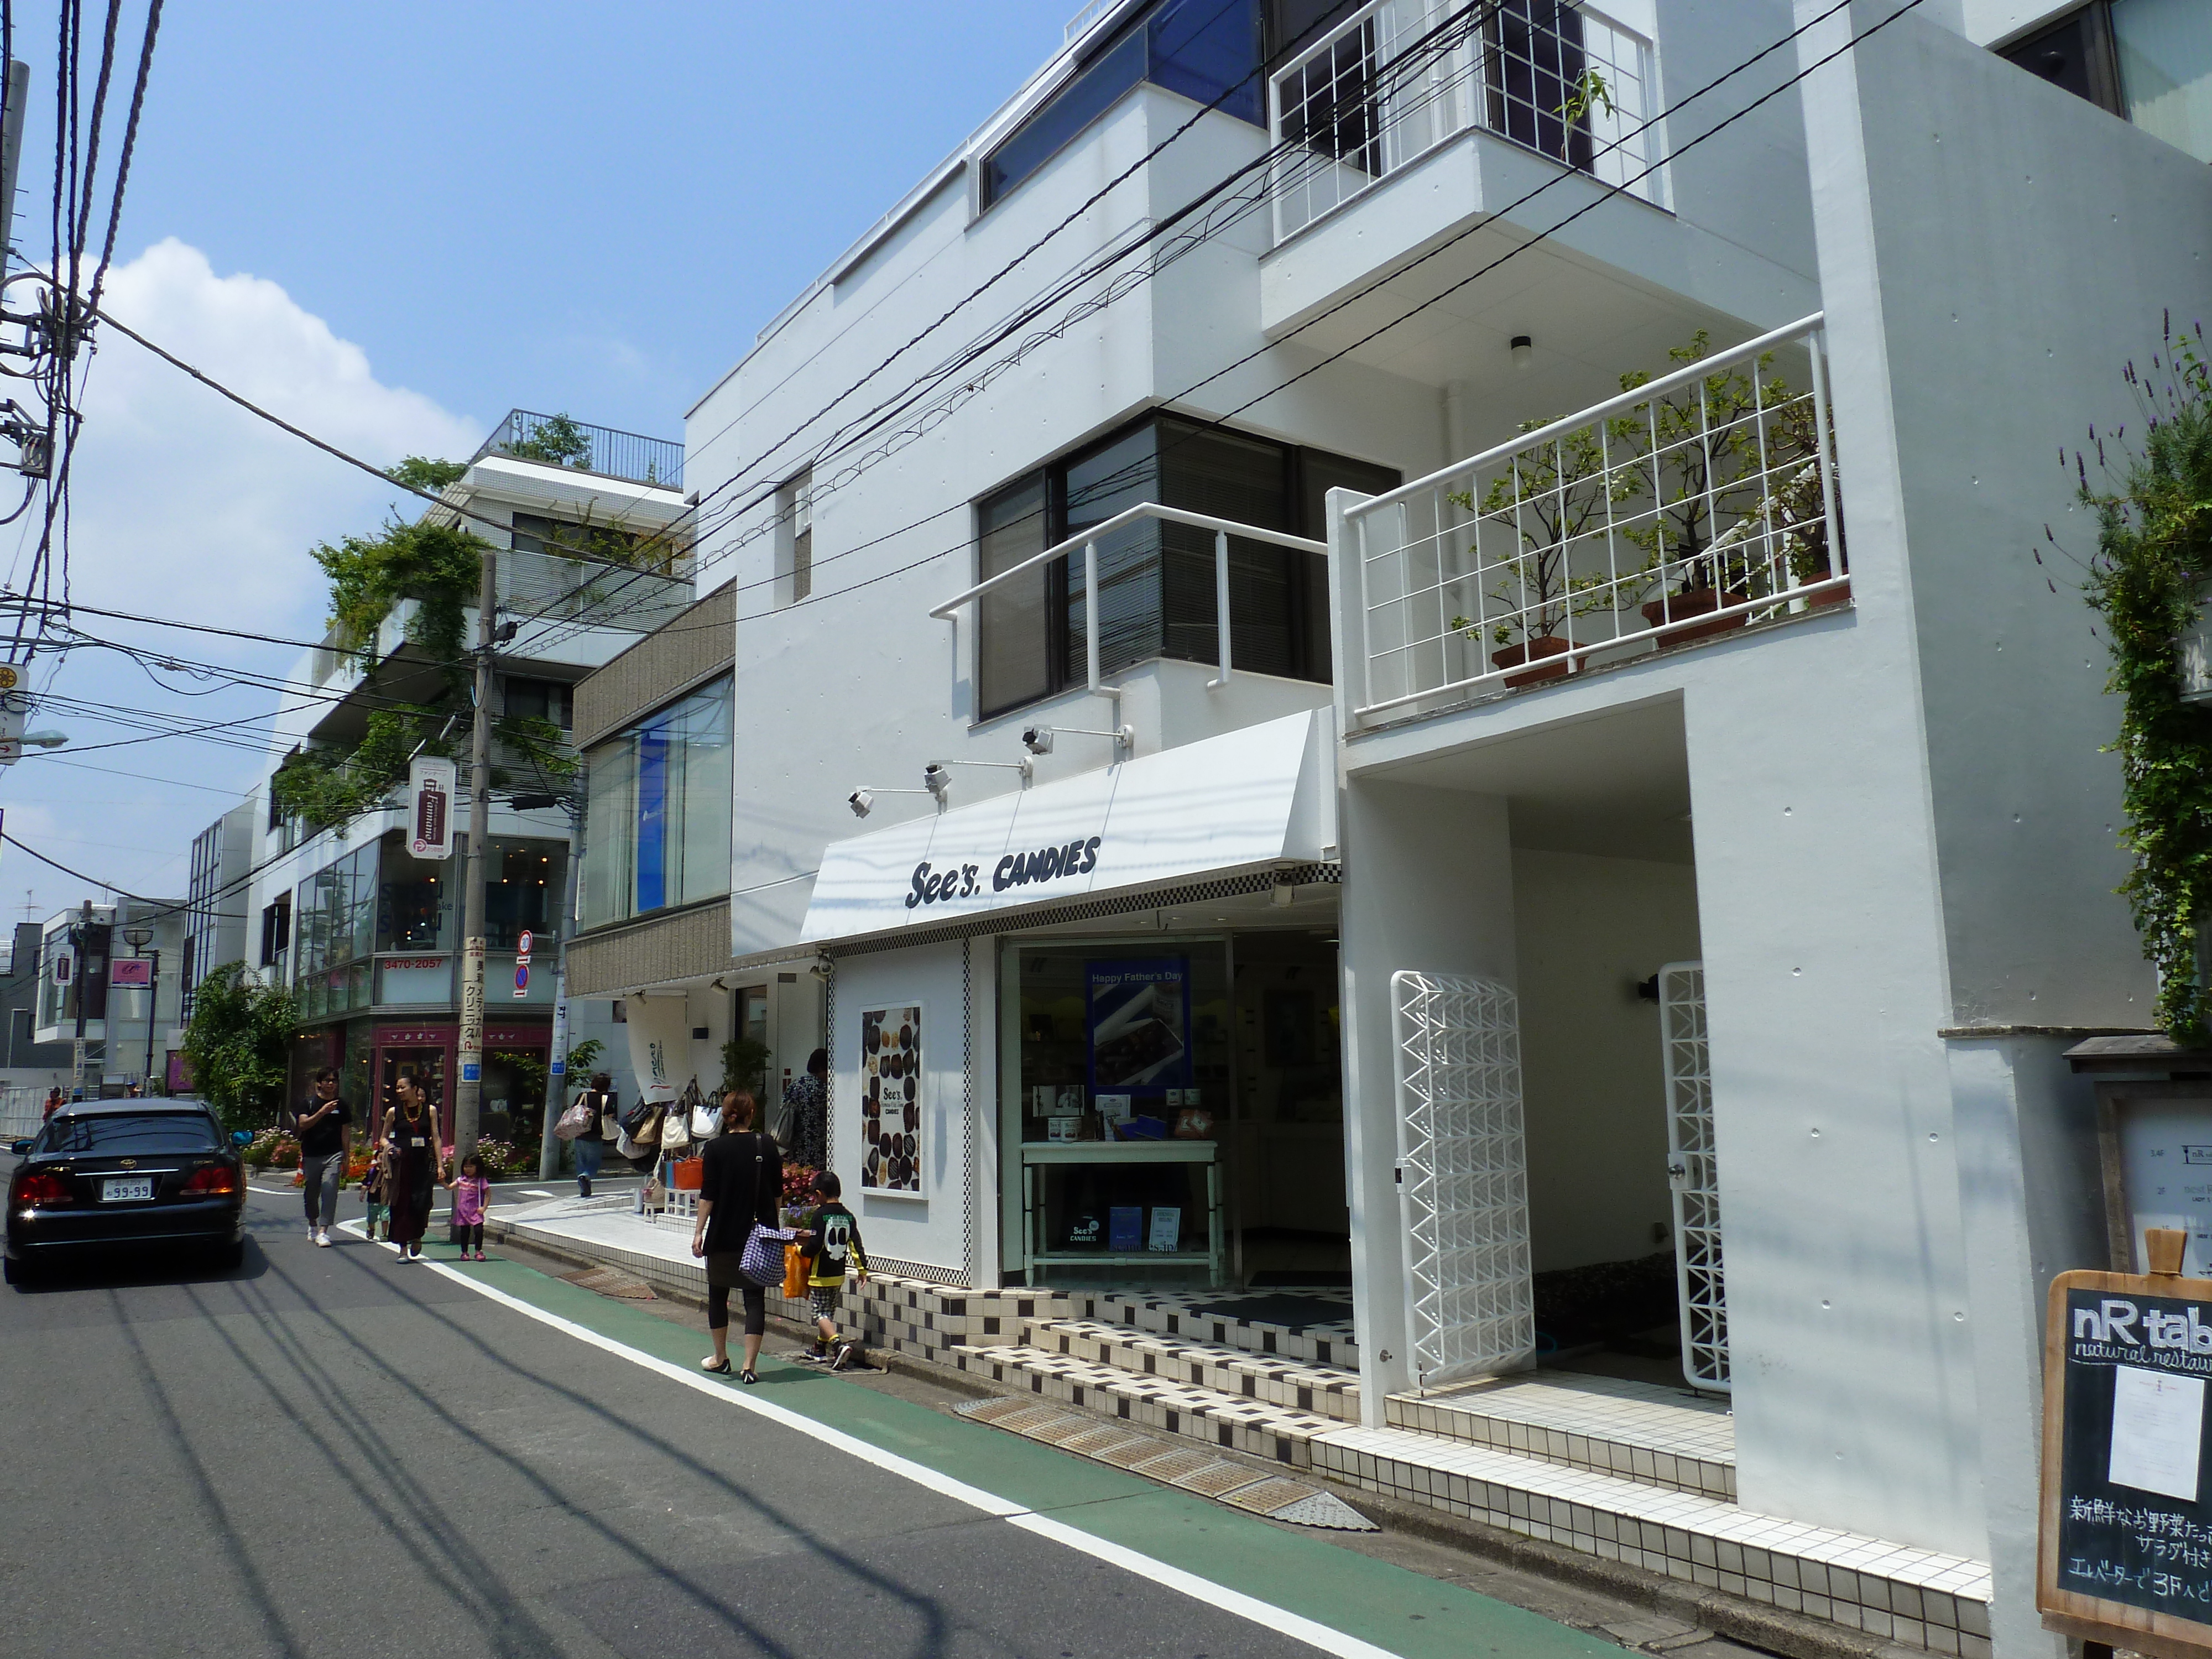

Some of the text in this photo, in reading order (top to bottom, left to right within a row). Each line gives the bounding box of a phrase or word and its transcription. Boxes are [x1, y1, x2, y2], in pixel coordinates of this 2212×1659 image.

[993, 836, 1101, 892] CANDIES
[384, 959, 442, 969] 3470-2057
[1093, 972, 1182, 983] Happy Father's Day
[114, 1187, 149, 1198] 99-99
[2074, 1300, 2212, 1355] nR tab
[2075, 1342, 2151, 1363] natural
[2135, 1534, 2211, 1569] サラダ付き
